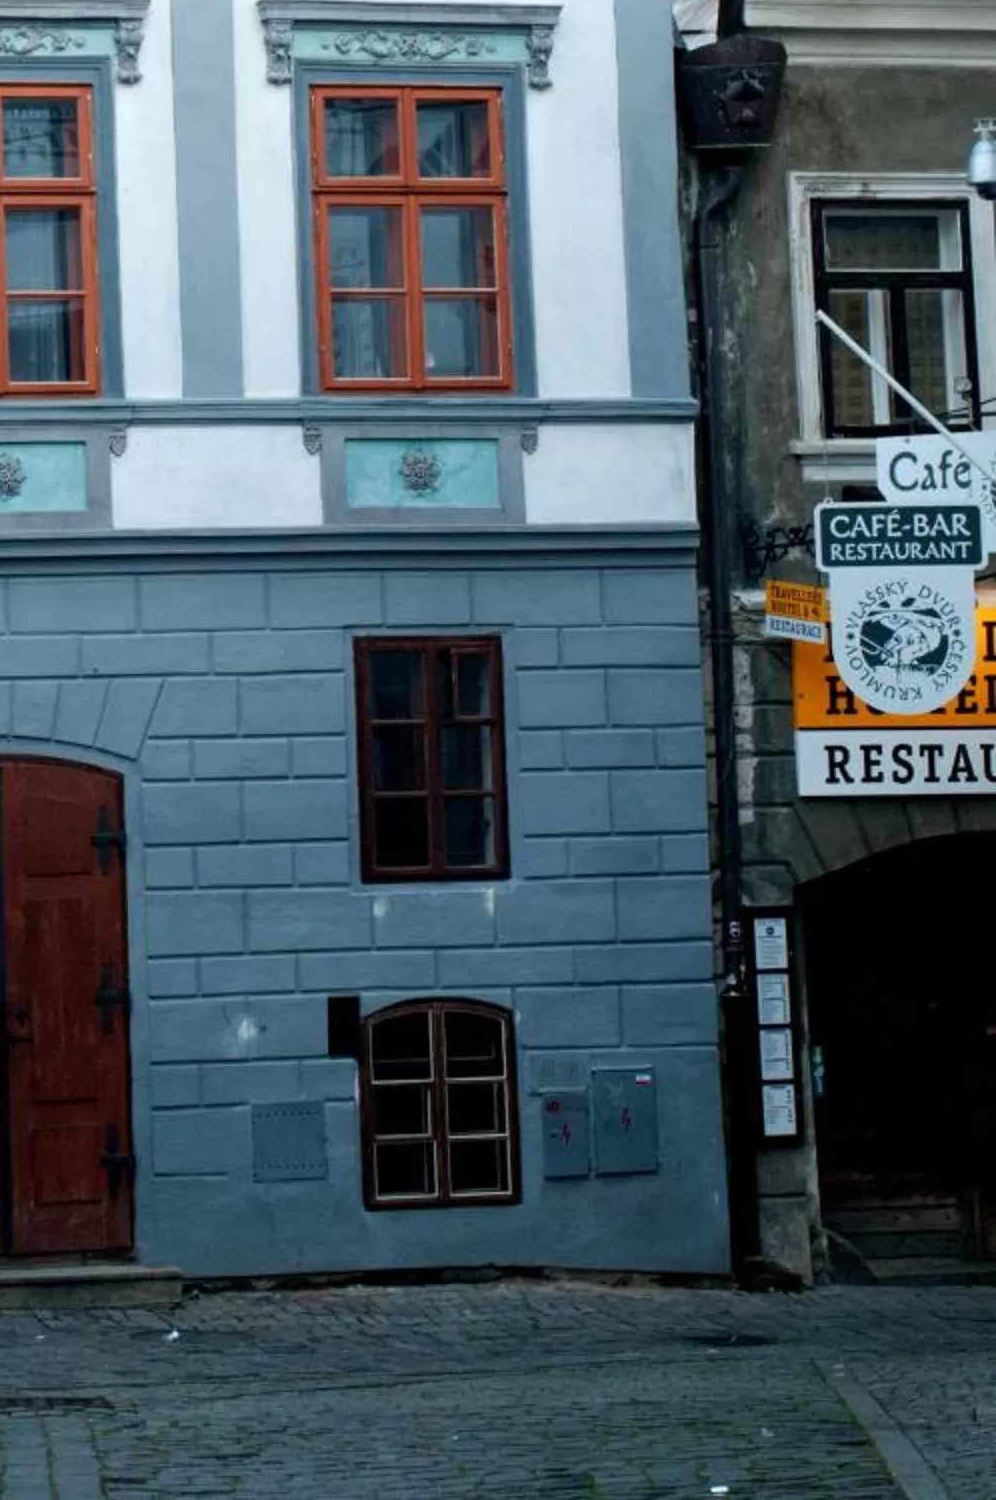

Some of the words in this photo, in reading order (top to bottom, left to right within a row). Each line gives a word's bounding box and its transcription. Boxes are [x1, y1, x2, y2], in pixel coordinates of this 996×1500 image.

[889, 449, 972, 492] Café
[829, 509, 971, 539] CAFÉ-BAR
[830, 541, 972, 562] RESTAURANT
